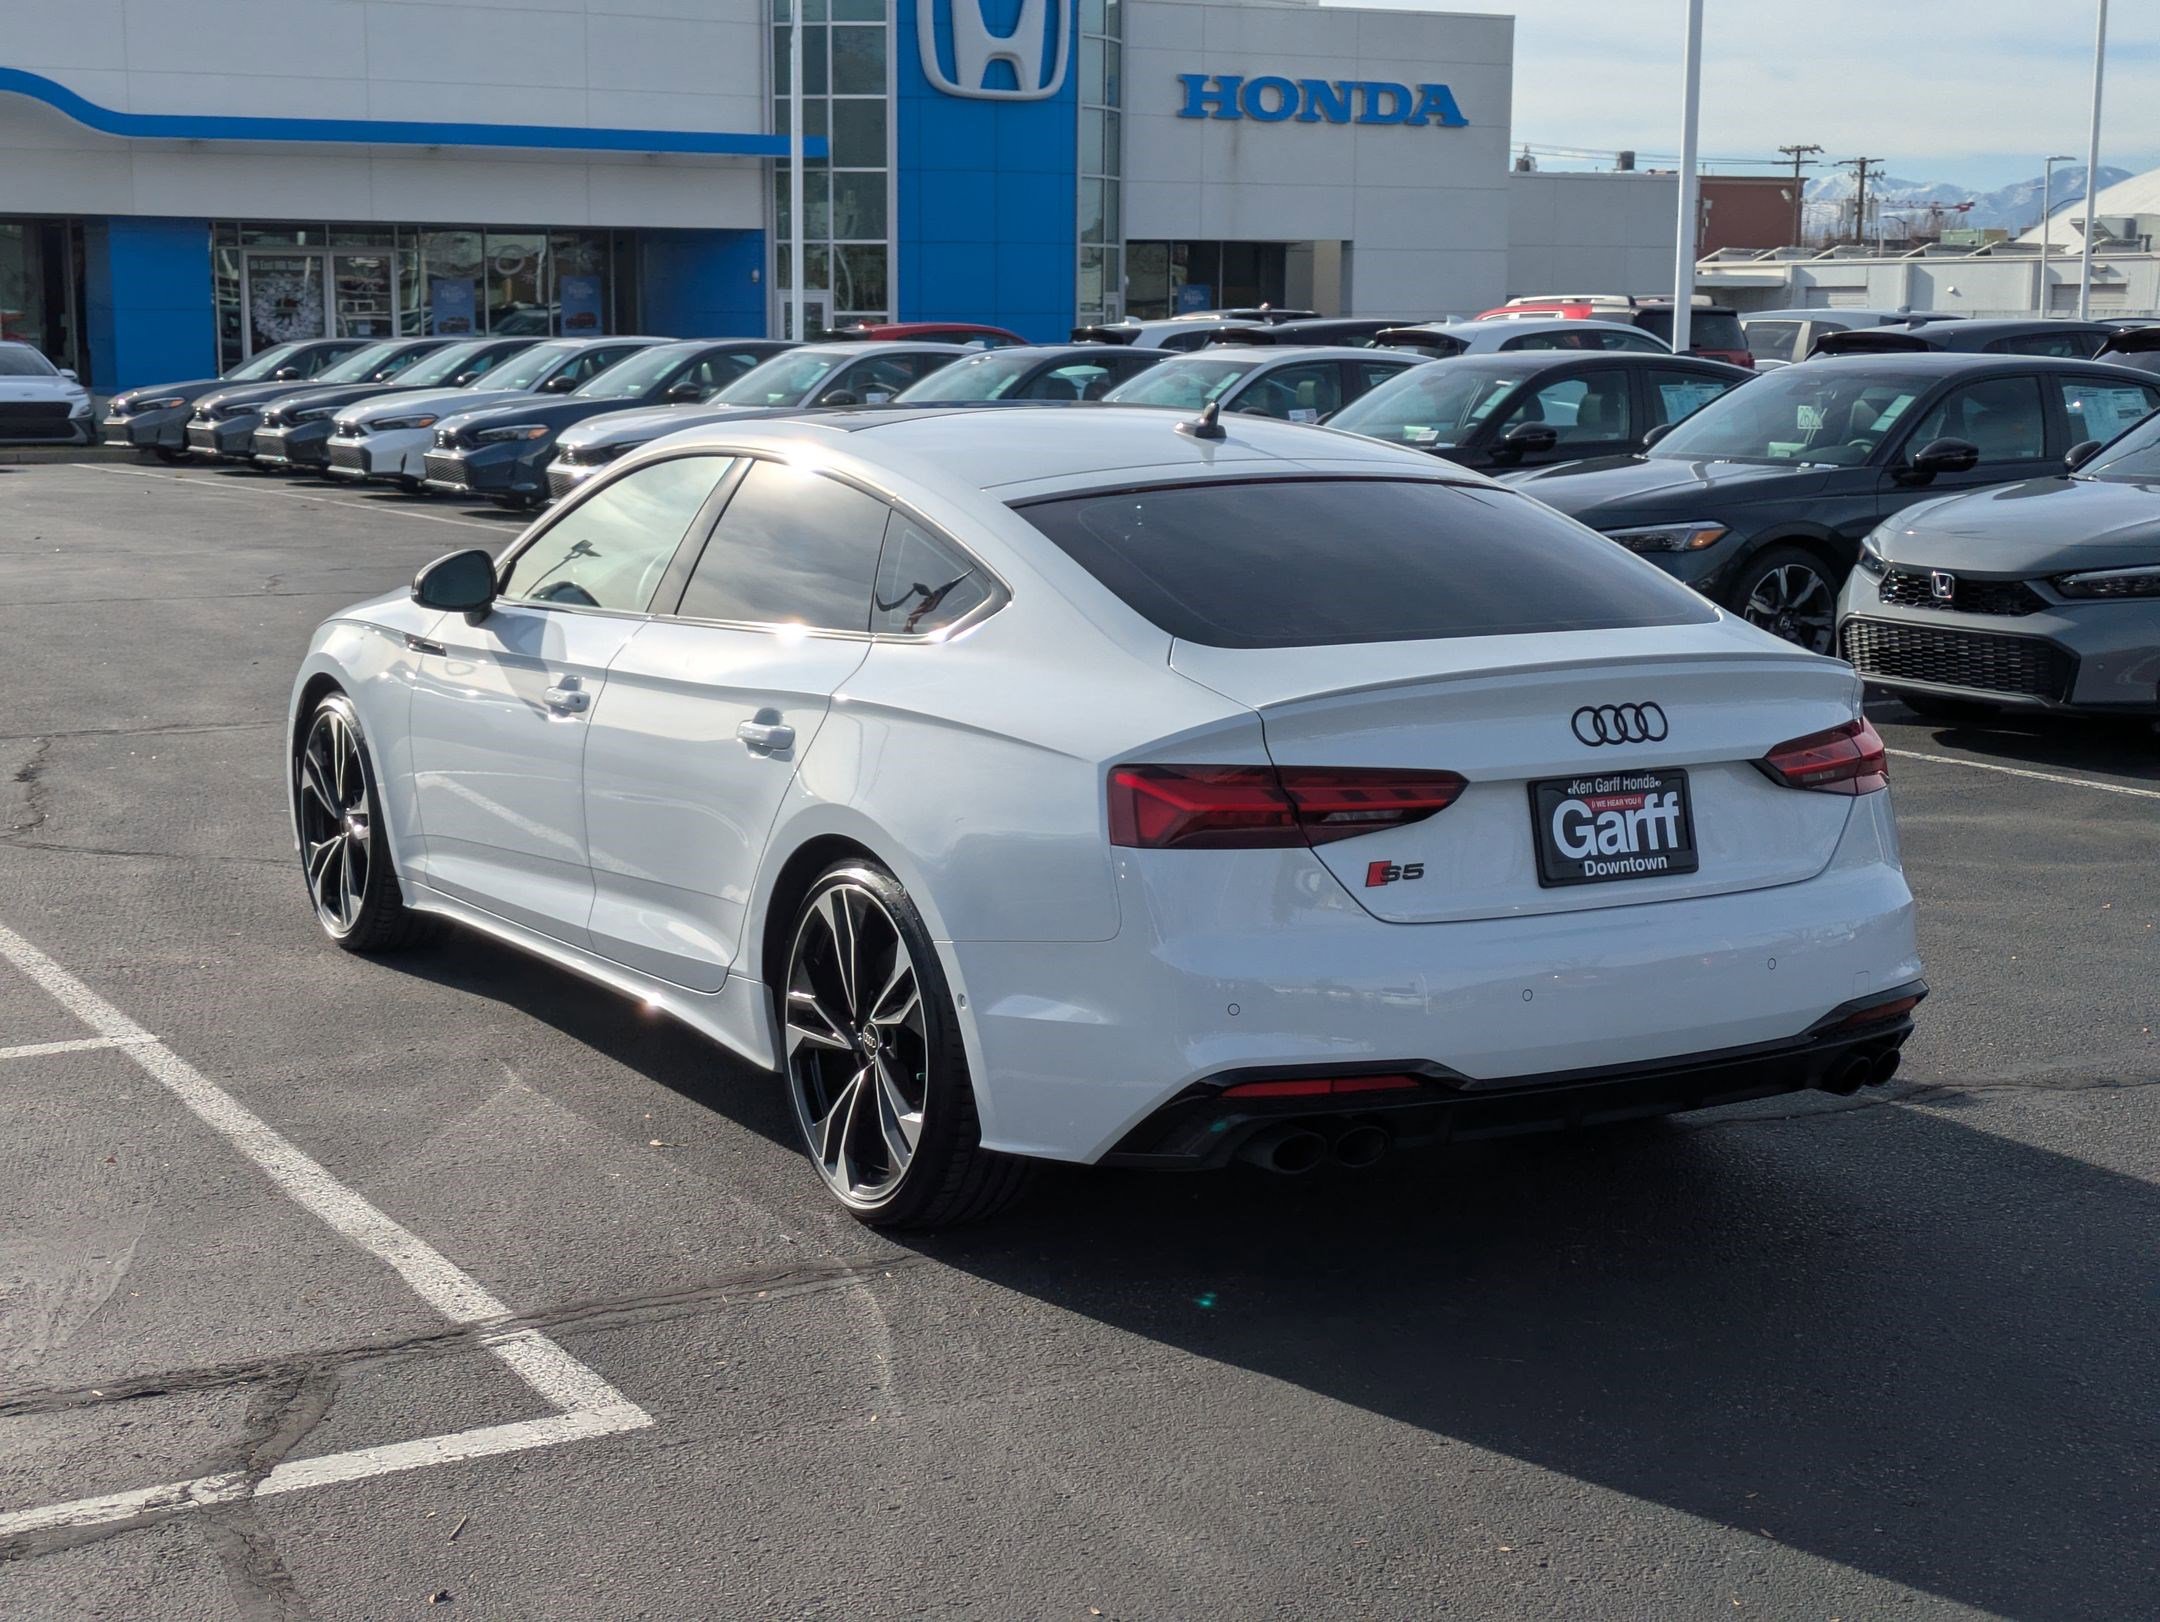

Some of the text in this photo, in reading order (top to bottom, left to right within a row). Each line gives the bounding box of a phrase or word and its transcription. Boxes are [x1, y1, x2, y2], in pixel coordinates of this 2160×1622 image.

[1176, 73, 1469, 127] HONDA
[1572, 773, 1655, 795] Ken Garff Honda
[1596, 796, 1637, 808] WE HEAR YOU
[1553, 791, 1680, 859] Garff
[1380, 862, 1424, 882] S5
[1584, 855, 1668, 877] Downtown
